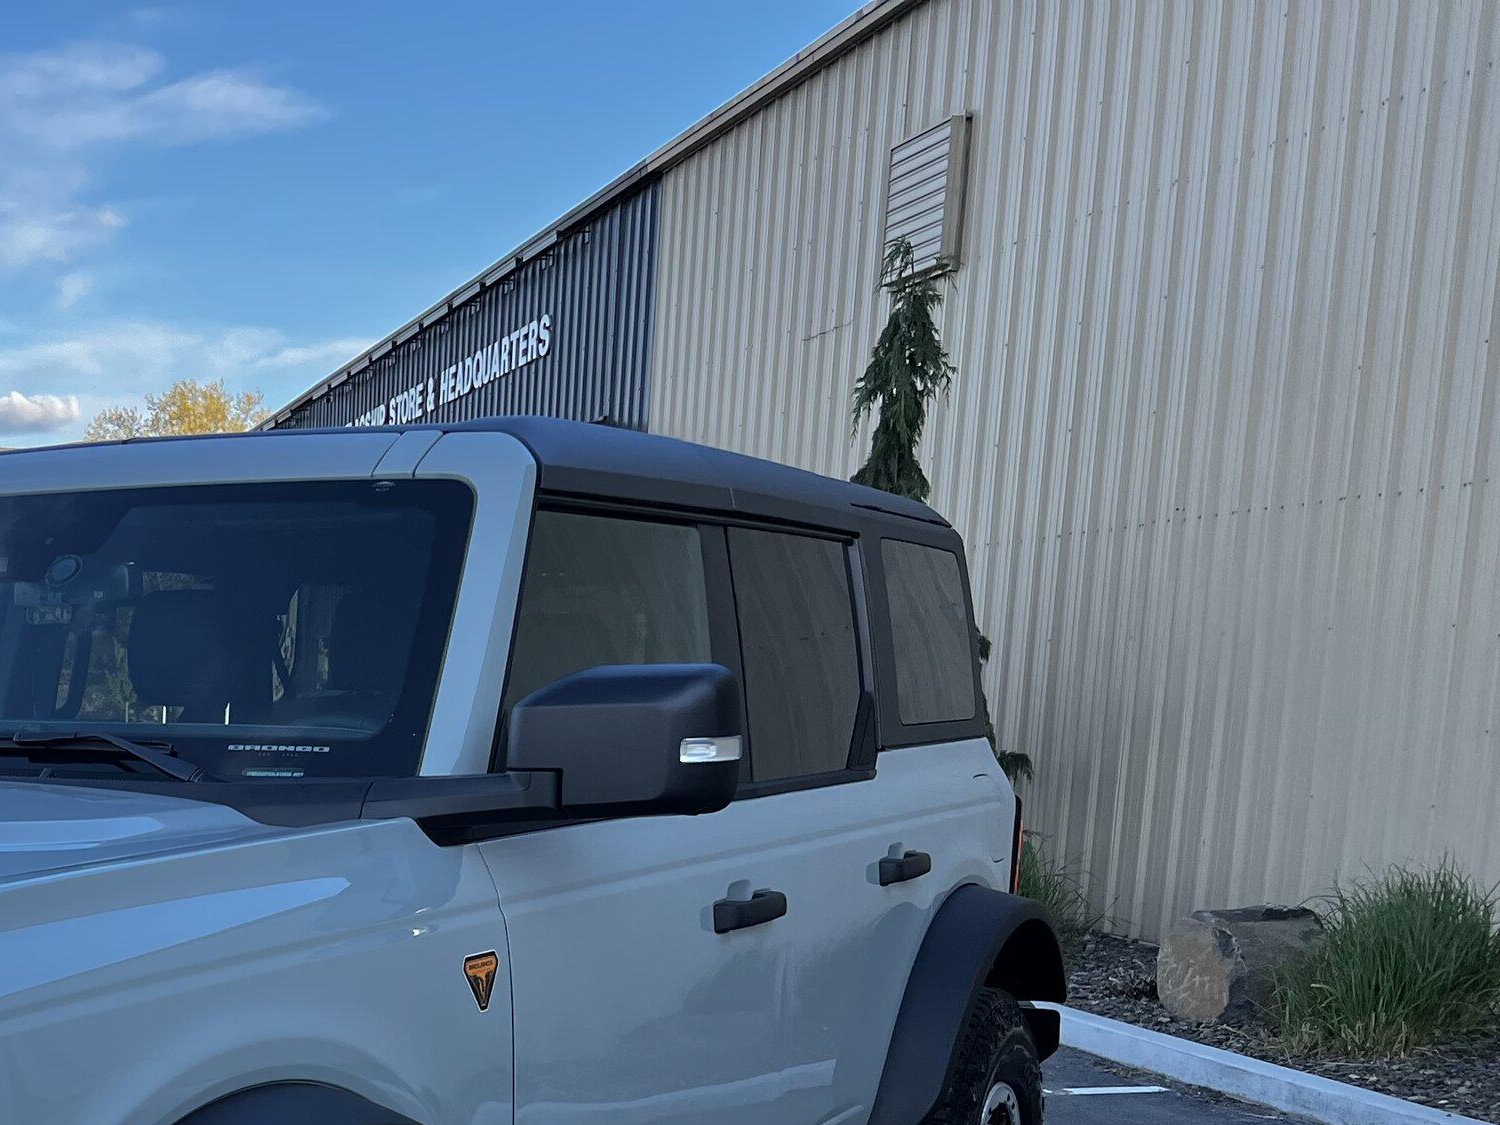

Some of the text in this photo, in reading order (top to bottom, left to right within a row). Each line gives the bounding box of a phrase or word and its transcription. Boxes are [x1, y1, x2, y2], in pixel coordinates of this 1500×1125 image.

[389, 383, 422, 424] STORE
[426, 377, 435, 412] &
[439, 314, 550, 405] HEADQUARTERS
